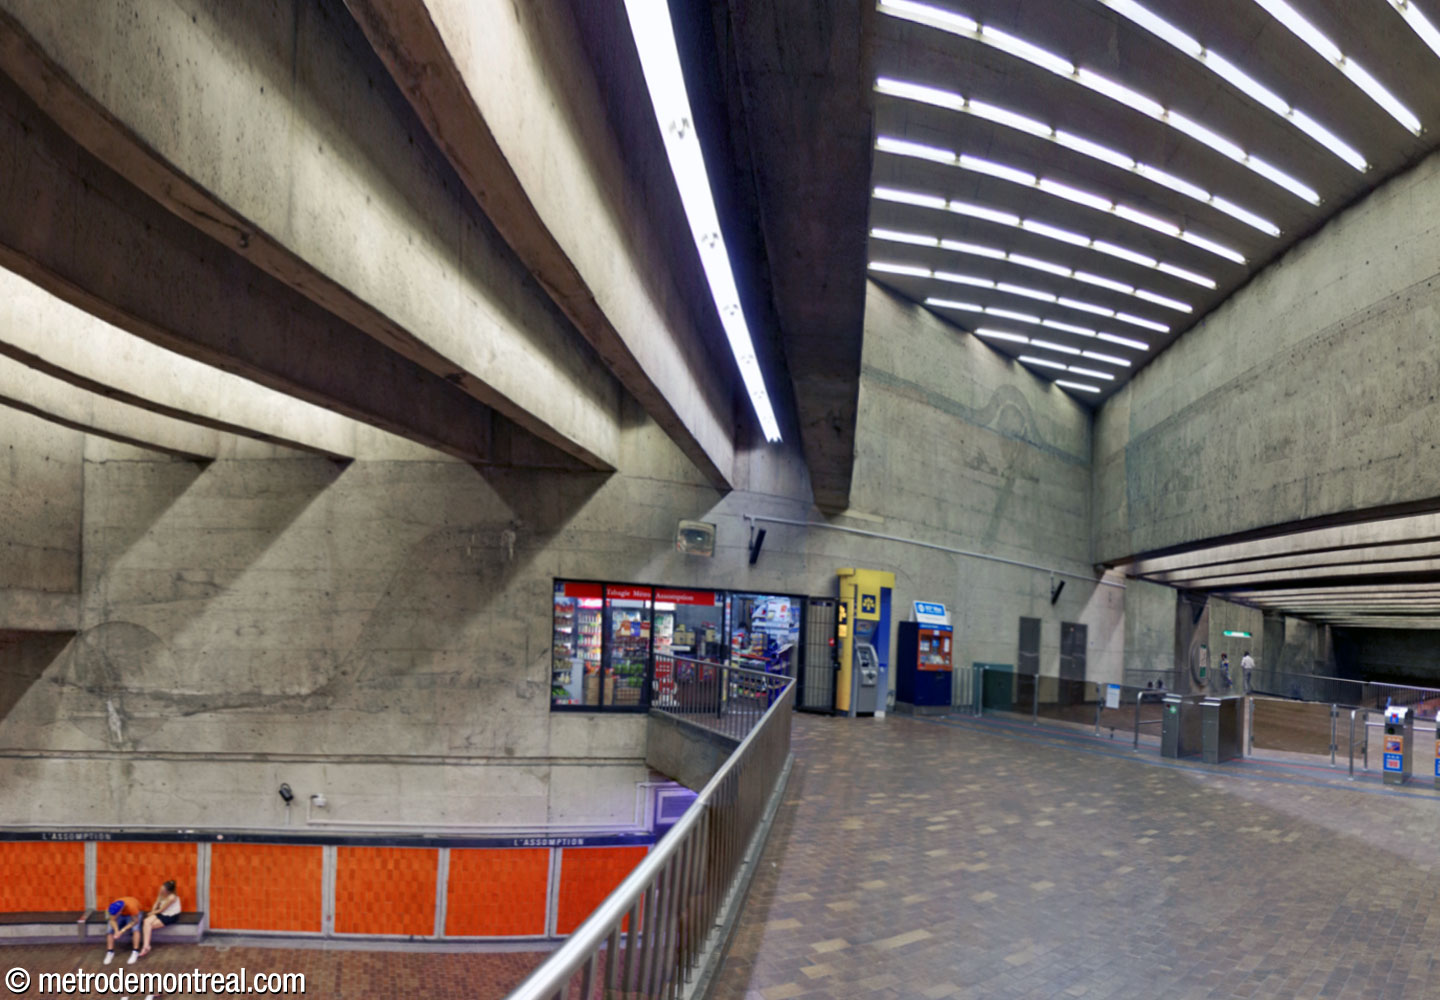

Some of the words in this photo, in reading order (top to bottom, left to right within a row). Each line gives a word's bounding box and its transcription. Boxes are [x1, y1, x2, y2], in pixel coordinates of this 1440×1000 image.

[655, 592, 695, 602] Assomption
[42, 832, 112, 840] L'ASSOMPTION
[514, 838, 584, 846] L'ASSOMPTION
